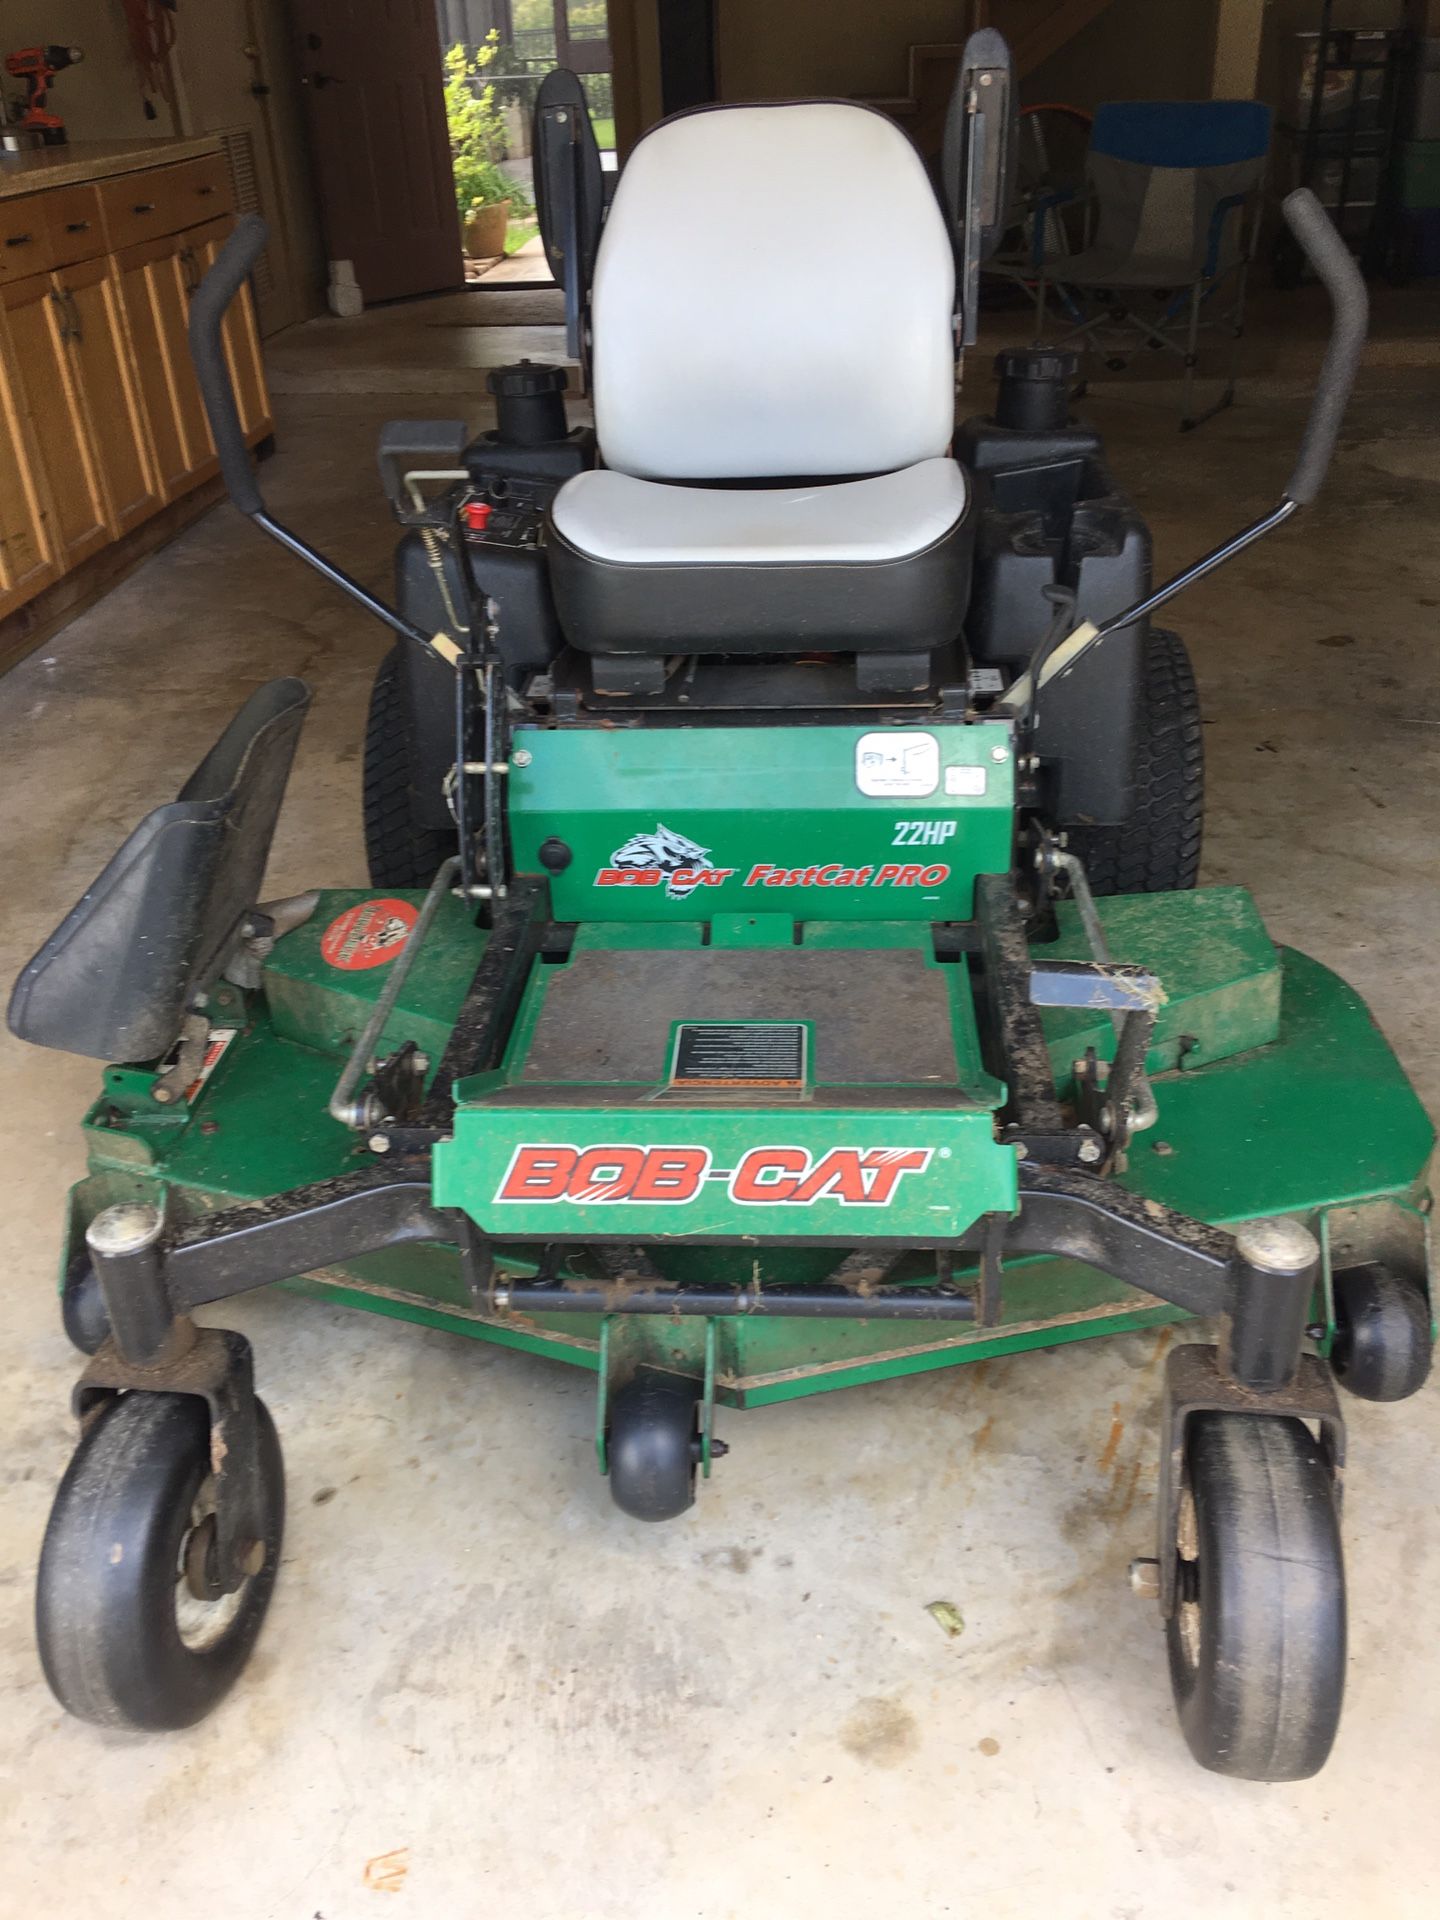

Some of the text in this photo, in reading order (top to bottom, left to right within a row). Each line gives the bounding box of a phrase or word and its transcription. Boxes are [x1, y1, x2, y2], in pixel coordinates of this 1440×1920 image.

[891, 820, 957, 846] 22HP
[592, 868, 735, 886] BOB-CAT
[743, 864, 951, 887] FastCat PRO
[491, 1143, 935, 1206] BOB-CAT
